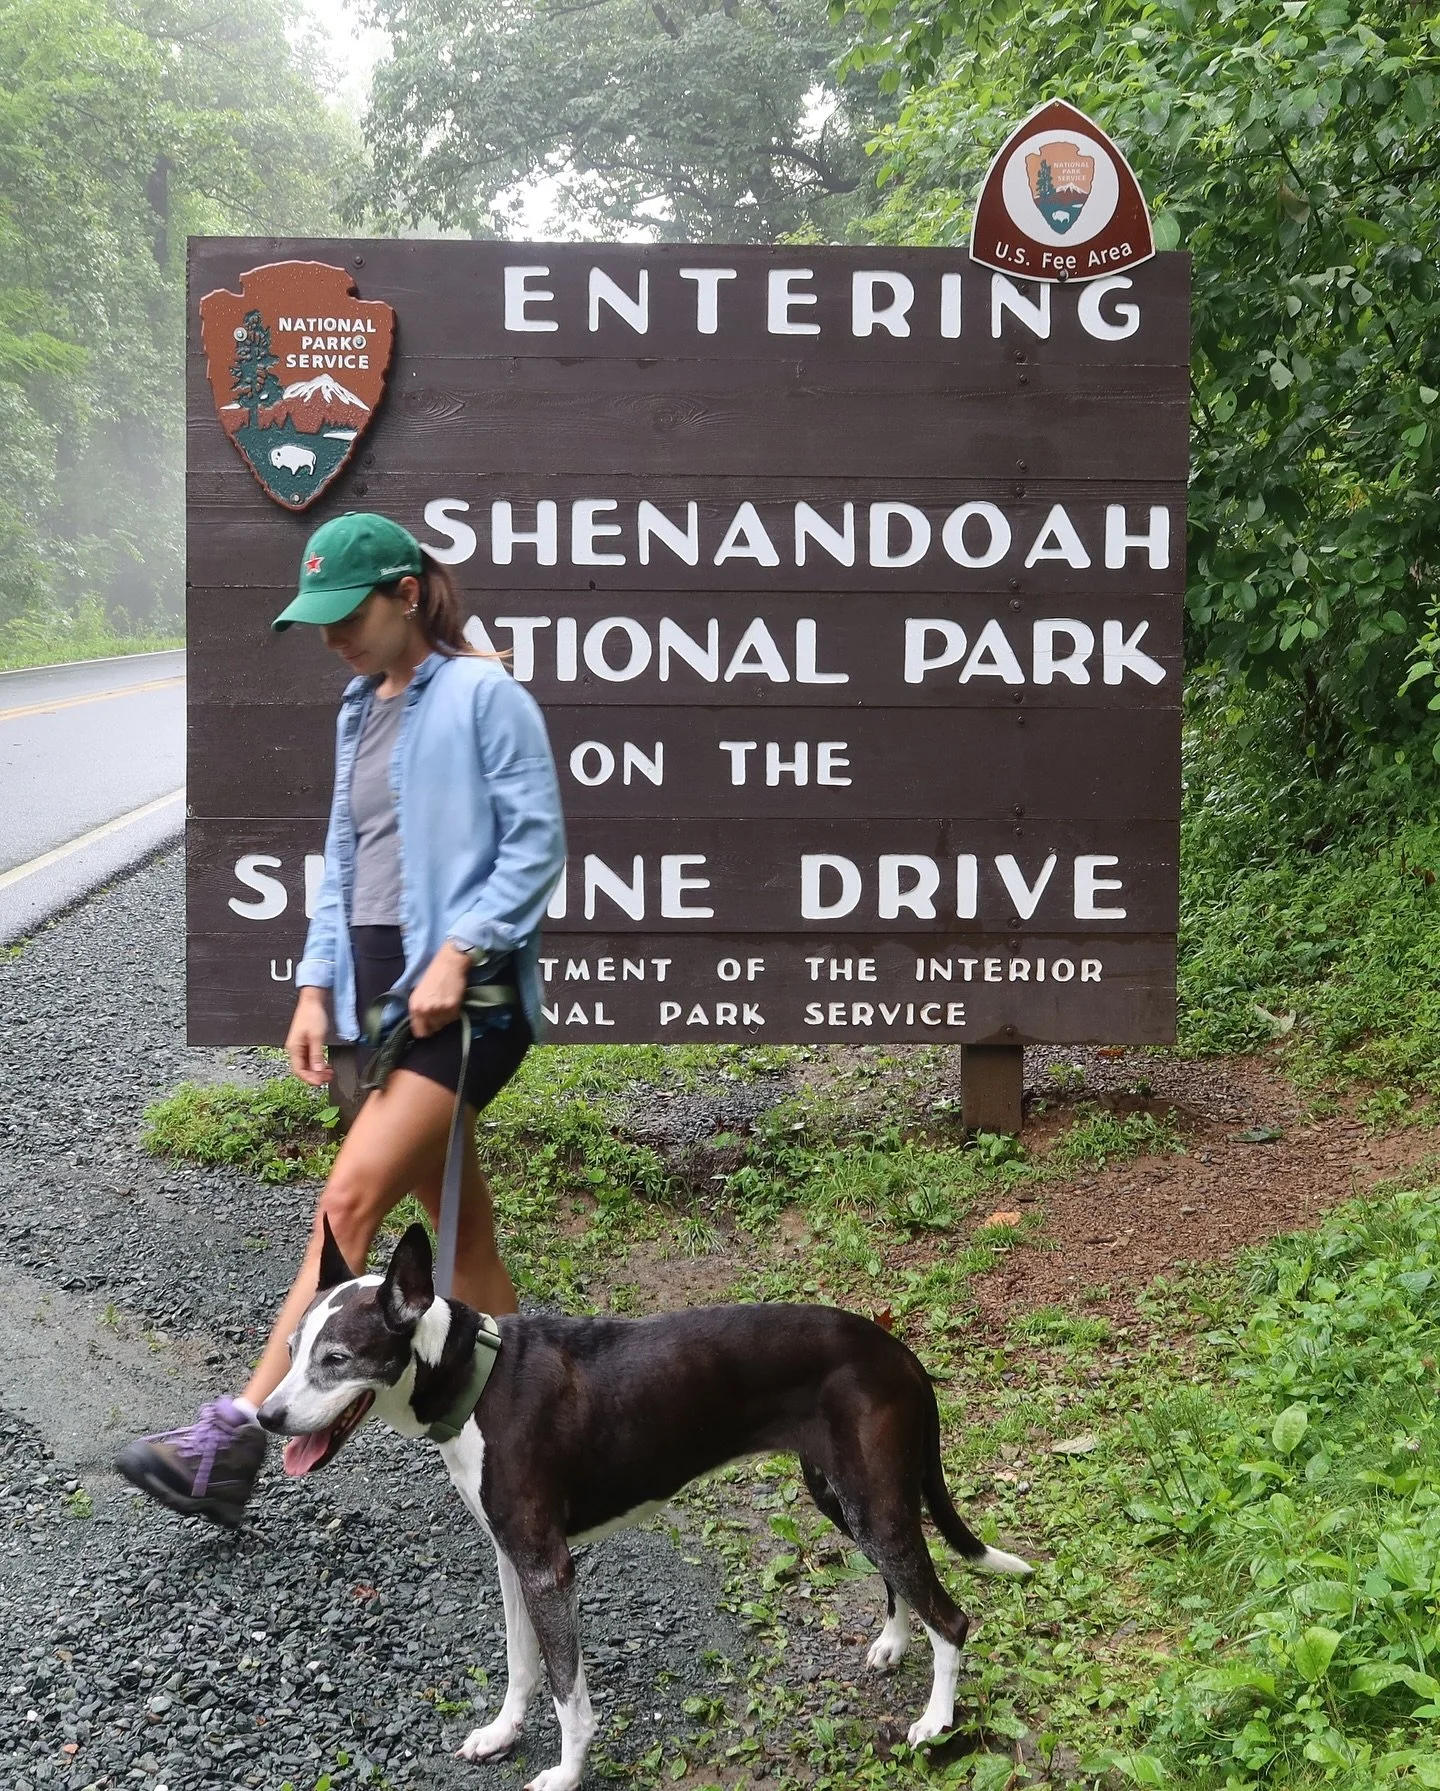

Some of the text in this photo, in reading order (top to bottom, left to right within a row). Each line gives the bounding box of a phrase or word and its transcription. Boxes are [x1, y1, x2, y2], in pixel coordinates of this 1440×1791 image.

[1053, 161, 1090, 169] NATIONAL
[995, 241, 1133, 270] U.S. Fee Area
[504, 265, 1141, 342] ENTERING
[278, 317, 377, 333] NATIONAL
[301, 335, 354, 351] PARK
[286, 354, 369, 370] SERVICE
[423, 498, 1171, 571] SHENANDOAH
[462, 614, 1167, 687] ATIONAL PARK
[569, 740, 853, 788] ON THE
[800, 853, 1128, 921] DRIVE
[716, 957, 766, 982] OF
[804, 957, 878, 982] THE
[915, 957, 1103, 984] INTERIOR
[659, 1001, 967, 1027] PARK SERVICE
